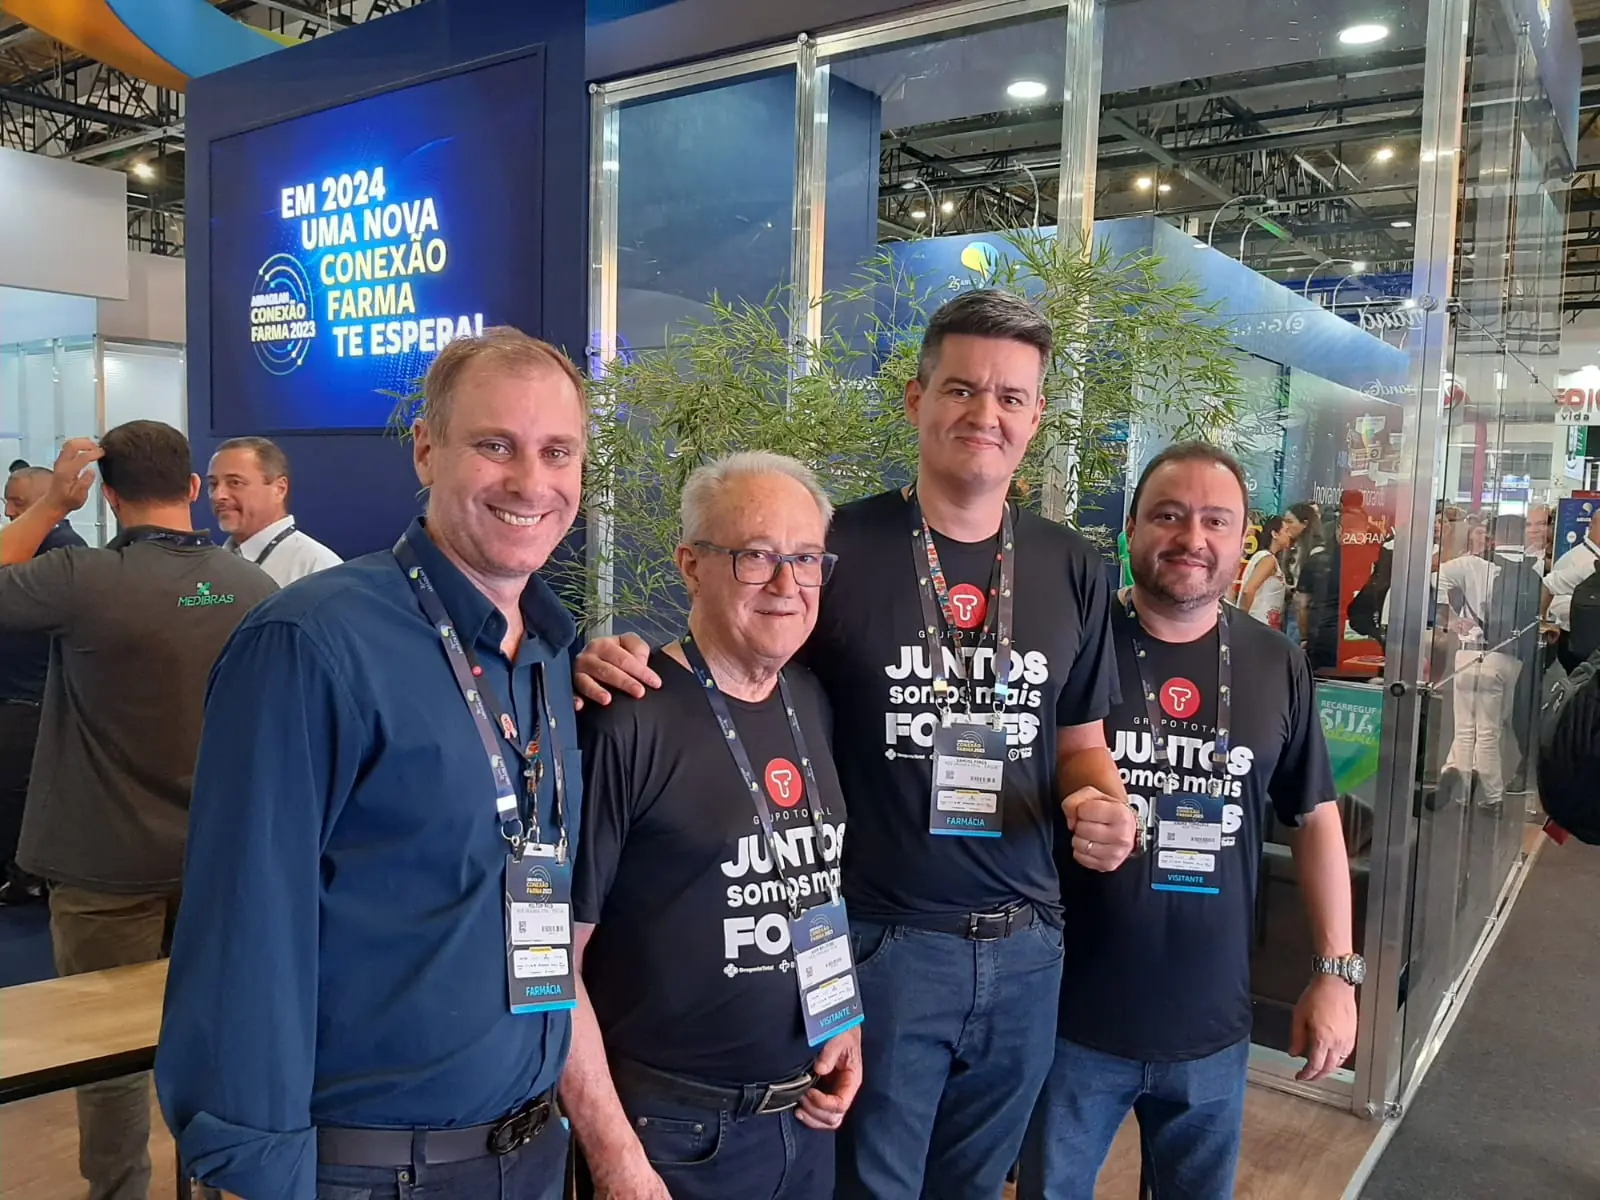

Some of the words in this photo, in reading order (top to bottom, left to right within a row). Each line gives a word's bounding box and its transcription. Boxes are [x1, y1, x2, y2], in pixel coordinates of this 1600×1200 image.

[281, 184, 316, 219] EM
[321, 166, 386, 211] 2024
[301, 212, 357, 250] UMA
[363, 197, 439, 241] NOVA
[319, 232, 448, 286] CONEXÃO
[251, 299, 306, 324] CONEXÃO
[327, 282, 416, 321] FARMA
[251, 323, 289, 342] FARMA
[290, 320, 316, 339] 2023
[332, 325, 363, 358] TE
[370, 313, 485, 356] ESPERA!
[1312, 480, 1344, 505] Inovand
[177, 594, 234, 607] MEDIBRAS
[884, 645, 1049, 685] JUNTOS
[1133, 717, 1177, 728] GRPO
[1182, 721, 1216, 734] TOTA
[1320, 708, 1374, 733] SUA
[1118, 766, 1181, 791] omos
[720, 822, 846, 878] JUNTOS
[727, 875, 811, 908] somos
[1167, 874, 1205, 884] VISITANTE
[525, 982, 562, 997] FARMÁCIA
[819, 1006, 850, 1028] VISITANTE
